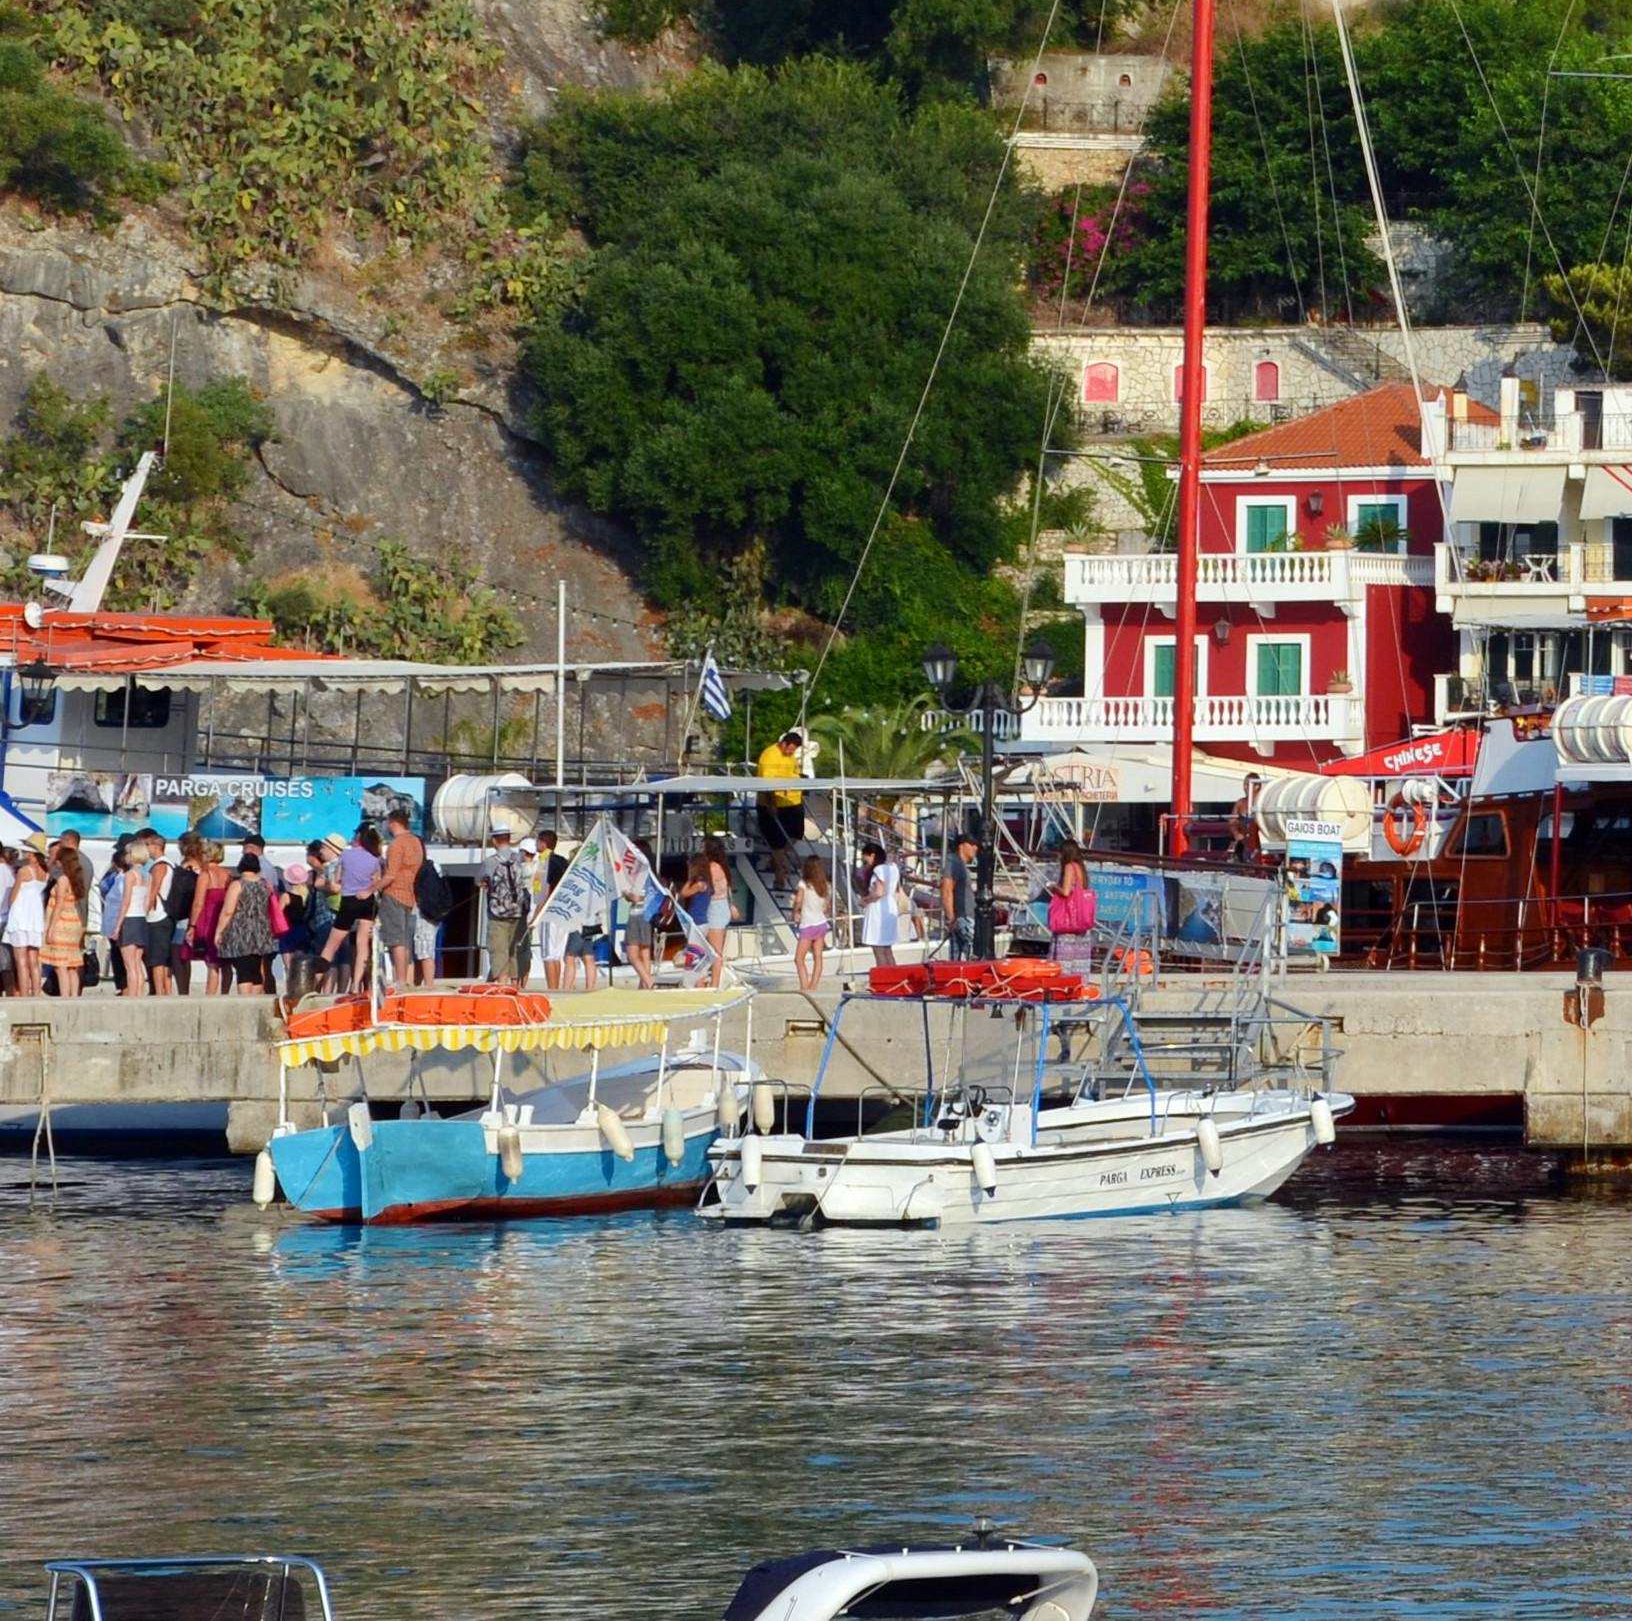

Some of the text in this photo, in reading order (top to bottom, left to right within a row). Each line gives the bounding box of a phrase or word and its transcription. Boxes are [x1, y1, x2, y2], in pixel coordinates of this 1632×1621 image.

[1047, 763, 1117, 789] STRIA
[156, 780, 314, 798] PARGA CRUISES
[1287, 821, 1342, 836] GAIOS BOAT
[1099, 1171, 1128, 1186] PARGA
[1140, 1163, 1176, 1180] EXPRESS
